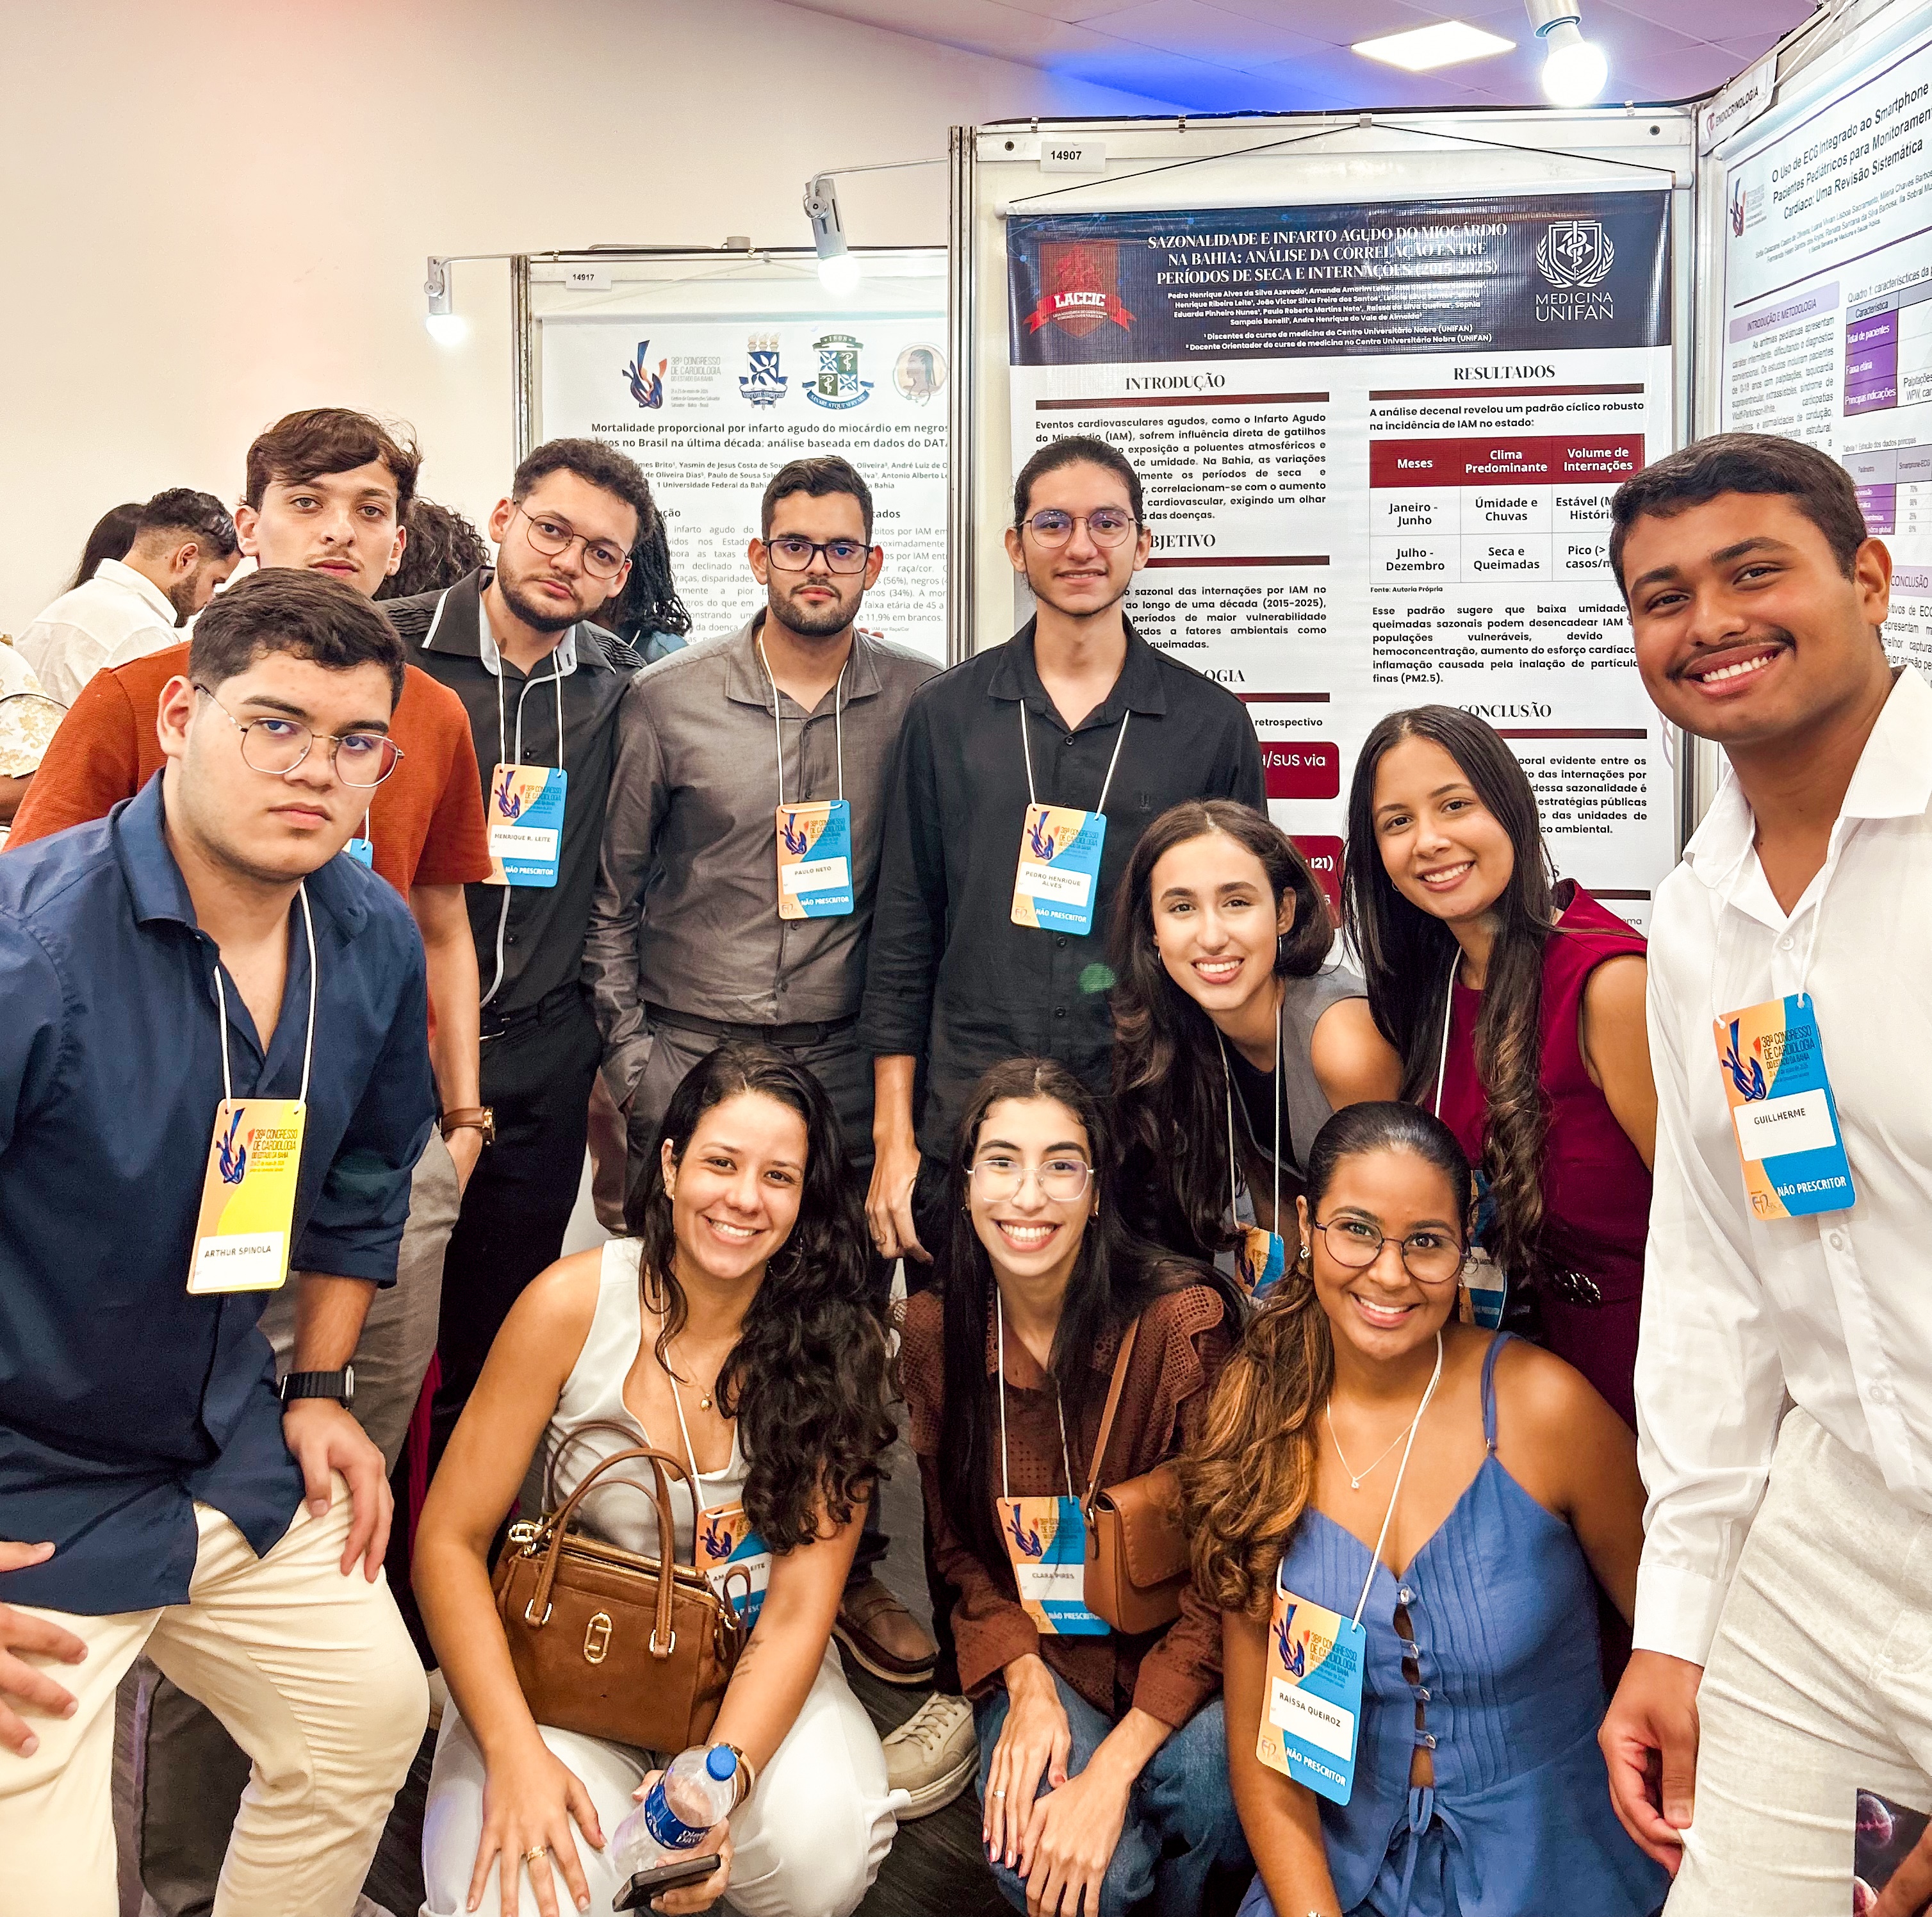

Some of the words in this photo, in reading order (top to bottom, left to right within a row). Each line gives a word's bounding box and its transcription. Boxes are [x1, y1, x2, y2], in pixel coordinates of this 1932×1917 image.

[1772, 169, 1778, 183] O
[1781, 164, 1791, 179] Uso
[1794, 156, 1801, 170] de
[1804, 144, 1818, 165] ECG
[1819, 124, 1858, 154] Integrado
[1860, 117, 1872, 131] ao
[1875, 83, 1929, 124] Smartphone
[1051, 151, 1081, 160] 14907
[1773, 179, 1804, 204] Pacientes
[1806, 154, 1847, 186] Pediátricos
[1850, 143, 1869, 165] para
[1872, 106, 1932, 151] Monitoramen
[1784, 195, 1814, 219] Cardíaco:
[1816, 185, 1832, 202] Uma
[1835, 167, 1869, 193] Revisão
[1872, 139, 1923, 176] Sistemática
[1148, 233, 1257, 249] SAZONALIDADE
[1261, 232, 1270, 245] E
[1273, 230, 1336, 245] INFARTO
[1340, 227, 1392, 242] AGUDO
[1396, 227, 1418, 240] DO
[1421, 222, 1508, 238] MIOCÁRDIO
[1168, 254, 1187, 266] NA
[1191, 252, 1241, 265] BAHIA:
[1245, 247, 1307, 263] ANÁLISE
[1311, 249, 1329, 261] DA
[1333, 242, 1432, 260] CORRELAÇÃO
[1436, 242, 1487, 256] ENTRE
[1157, 268, 1229, 284] PERÍODOS
[1233, 269, 1251, 282] DE
[1255, 268, 1291, 281] SECA
[1296, 267, 1304, 279] E
[1309, 262, 1412, 280] INTERNAÇÕES
[1054, 292, 1106, 308] LACCIC
[1537, 293, 1613, 304] MEDICINA
[1537, 305, 1613, 321] UNIFAN
[1439, 324, 1473, 333] (UNIFAN)
[1455, 365, 1555, 379] RESULTADOS
[1126, 373, 1225, 391] INTRODUÇÃO
[1379, 407, 1417, 416] análise
[1420, 406, 1461, 415] decenal
[1526, 404, 1564, 415] padrão
[1566, 402, 1600, 411] cíclico
[1078, 418, 1163, 427] cardiovasculares
[1168, 417, 1207, 427] agudos,
[1255, 415, 1288, 423] Infarto
[1293, 414, 1325, 424] Agudo
[592, 424, 655, 432] Mortalidade
[659, 424, 724, 434] proporcional
[728, 426, 745, 434] por
[788, 424, 819, 434] agudo
[1104, 431, 1134, 443] (IAM),
[1179, 429, 1228, 438] influência
[1233, 429, 1263, 437] direta
[1284, 427, 1325, 438] gatilhos
[639, 438, 667, 447] Brasil
[687, 438, 720, 447] última
[724, 439, 765, 447] década:
[767, 439, 804, 447] análise
[808, 439, 850, 447] baseada
[874, 439, 905, 447] dados
[1490, 450, 1522, 459] Clima
[1568, 448, 1612, 457] Volume
[1614, 447, 1628, 457] de
[1151, 457, 1199, 466] umidade.
[1222, 456, 1253, 465] Bahia,
[1276, 455, 1325, 465] variações
[1398, 459, 1432, 468] Meses
[1466, 463, 1548, 473] Predominante
[1564, 461, 1633, 473] Internações
[1476, 497, 1527, 507] Úmidade
[1557, 497, 1596, 506] Estável
[1389, 502, 1430, 514] Janeiro
[1486, 512, 1527, 520] Chuvas
[1570, 509, 1613, 520] Históri
[1397, 516, 1431, 527] Junho
[1150, 534, 1216, 550] BJETIVO
[1396, 548, 1426, 559] Julho
[1489, 547, 1514, 555] Seca
[1569, 545, 1591, 554] Pico
[1387, 561, 1445, 570] Dezembro
[1474, 560, 1539, 571] Queimadas
[702, 574, 754, 584] disparidades
[1890, 574, 1929, 589] CONCLUSÃO
[1143, 601, 1170, 611] longo
[1263, 598, 1325, 609] (2015-2025),
[1254, 718, 1322, 729] retrospectivo
[1539, 797, 1598, 808] estratégias
[1601, 797, 1646, 808] públicas
[1555, 825, 1612, 833] ambiental.
[505, 865, 518, 873] NÃO
[520, 866, 553, 876] PRESCRITOR
[1026, 871, 1047, 880] PEDRO
[1049, 875, 1081, 887] HENRIQUE
[1051, 910, 1087, 923] PRESCRITOR
[1774, 1024, 1812, 1045] CONGRESSO
[1764, 1048, 1773, 1060] DE
[1774, 1038, 1816, 1058] CARDIOLOGIA
[1754, 1108, 1806, 1125] GUILLHERME
[1777, 1183, 1795, 1197] NÃO
[1796, 1176, 1847, 1194] PRESCRITOR
[204, 1249, 236, 1258] ARTHUR
[239, 1246, 271, 1255] SPINOLA
[1279, 1691, 1306, 1711] RAÍSSA
[1307, 1705, 1341, 1728] QUEIROZ
[1286, 1745, 1303, 1763] NÃO
[1303, 1756, 1347, 1787] PRESCRITOR
